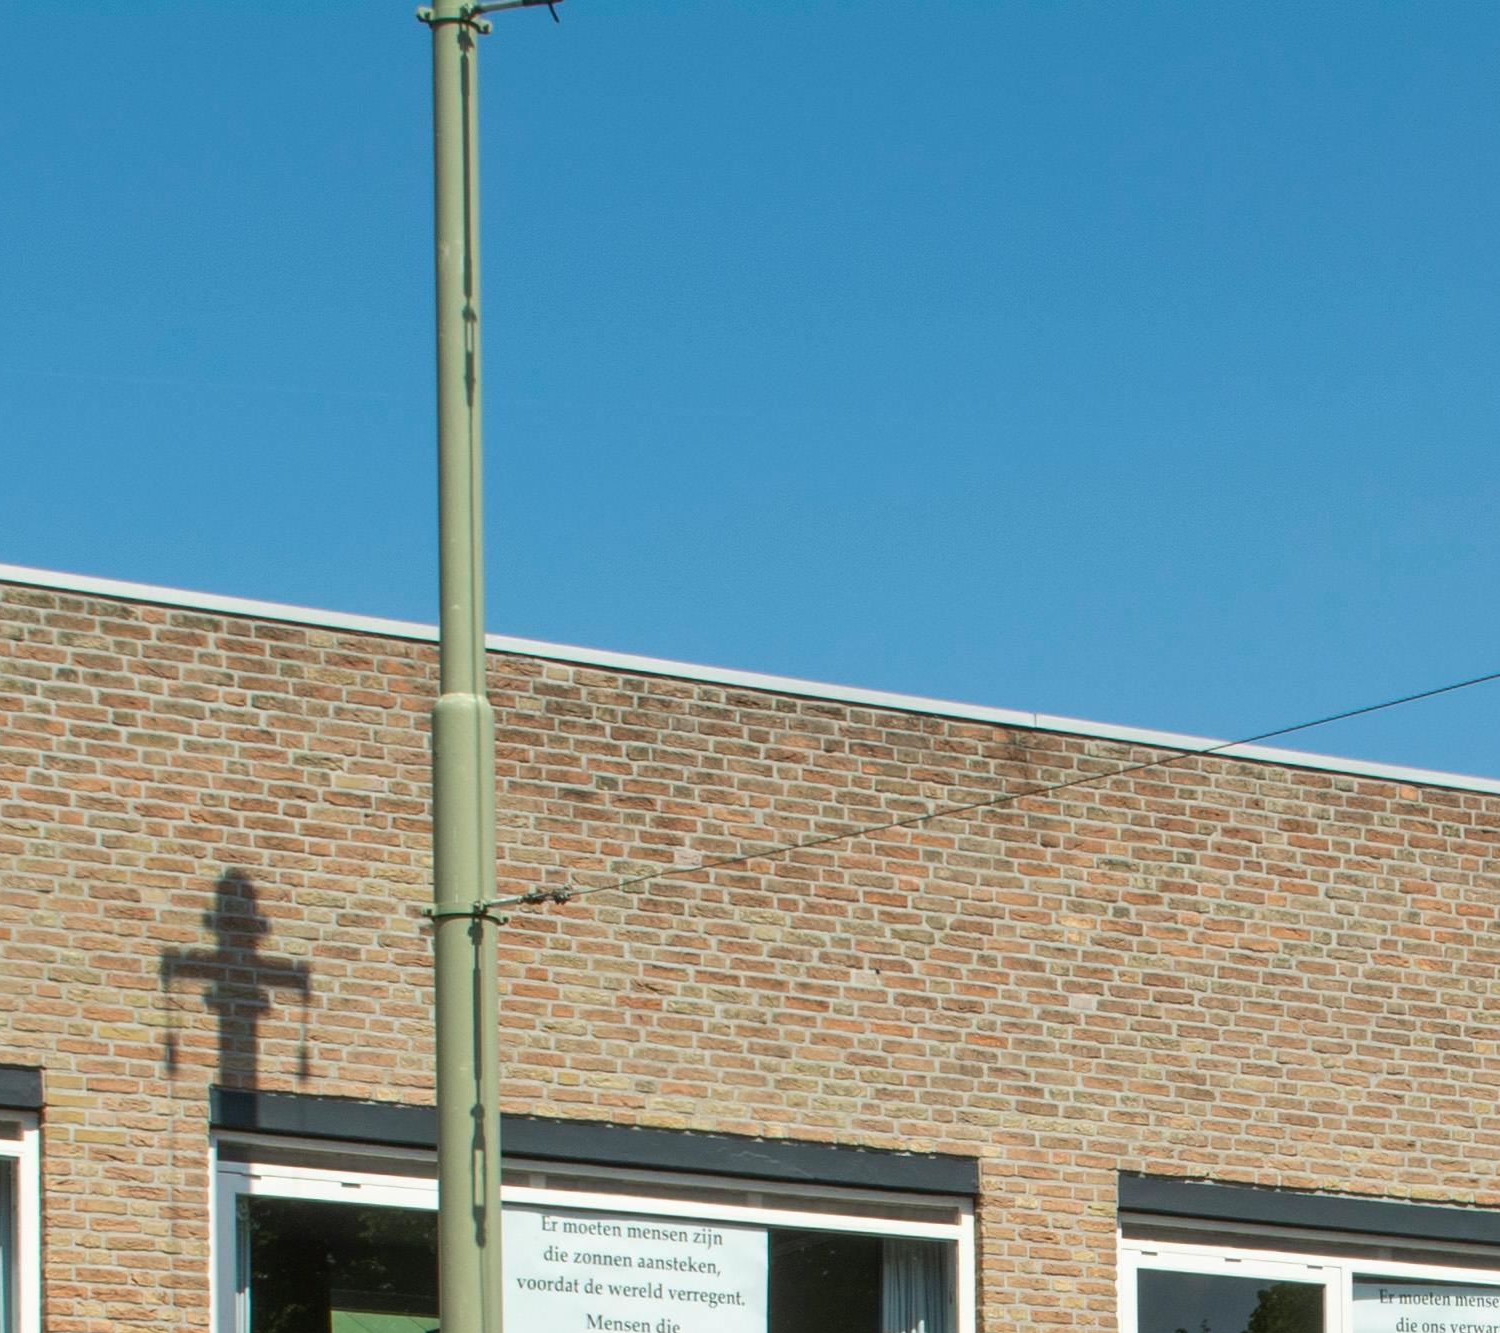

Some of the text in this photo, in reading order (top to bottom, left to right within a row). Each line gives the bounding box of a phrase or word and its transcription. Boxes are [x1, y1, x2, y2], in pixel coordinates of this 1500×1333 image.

[541, 1215, 723, 1249] Er moeten mensen zijn
[543, 1245, 720, 1277] die zonnen aansteken,
[517, 1276, 745, 1308] voordat de wereld verregent.
[1379, 1288, 1395, 1303] Er
[1399, 1290, 1451, 1306] moeten
[586, 1313, 650, 1333] Mensen
[1396, 1317, 1418, 1333] die
[1422, 1322, 1446, 1333] ons
